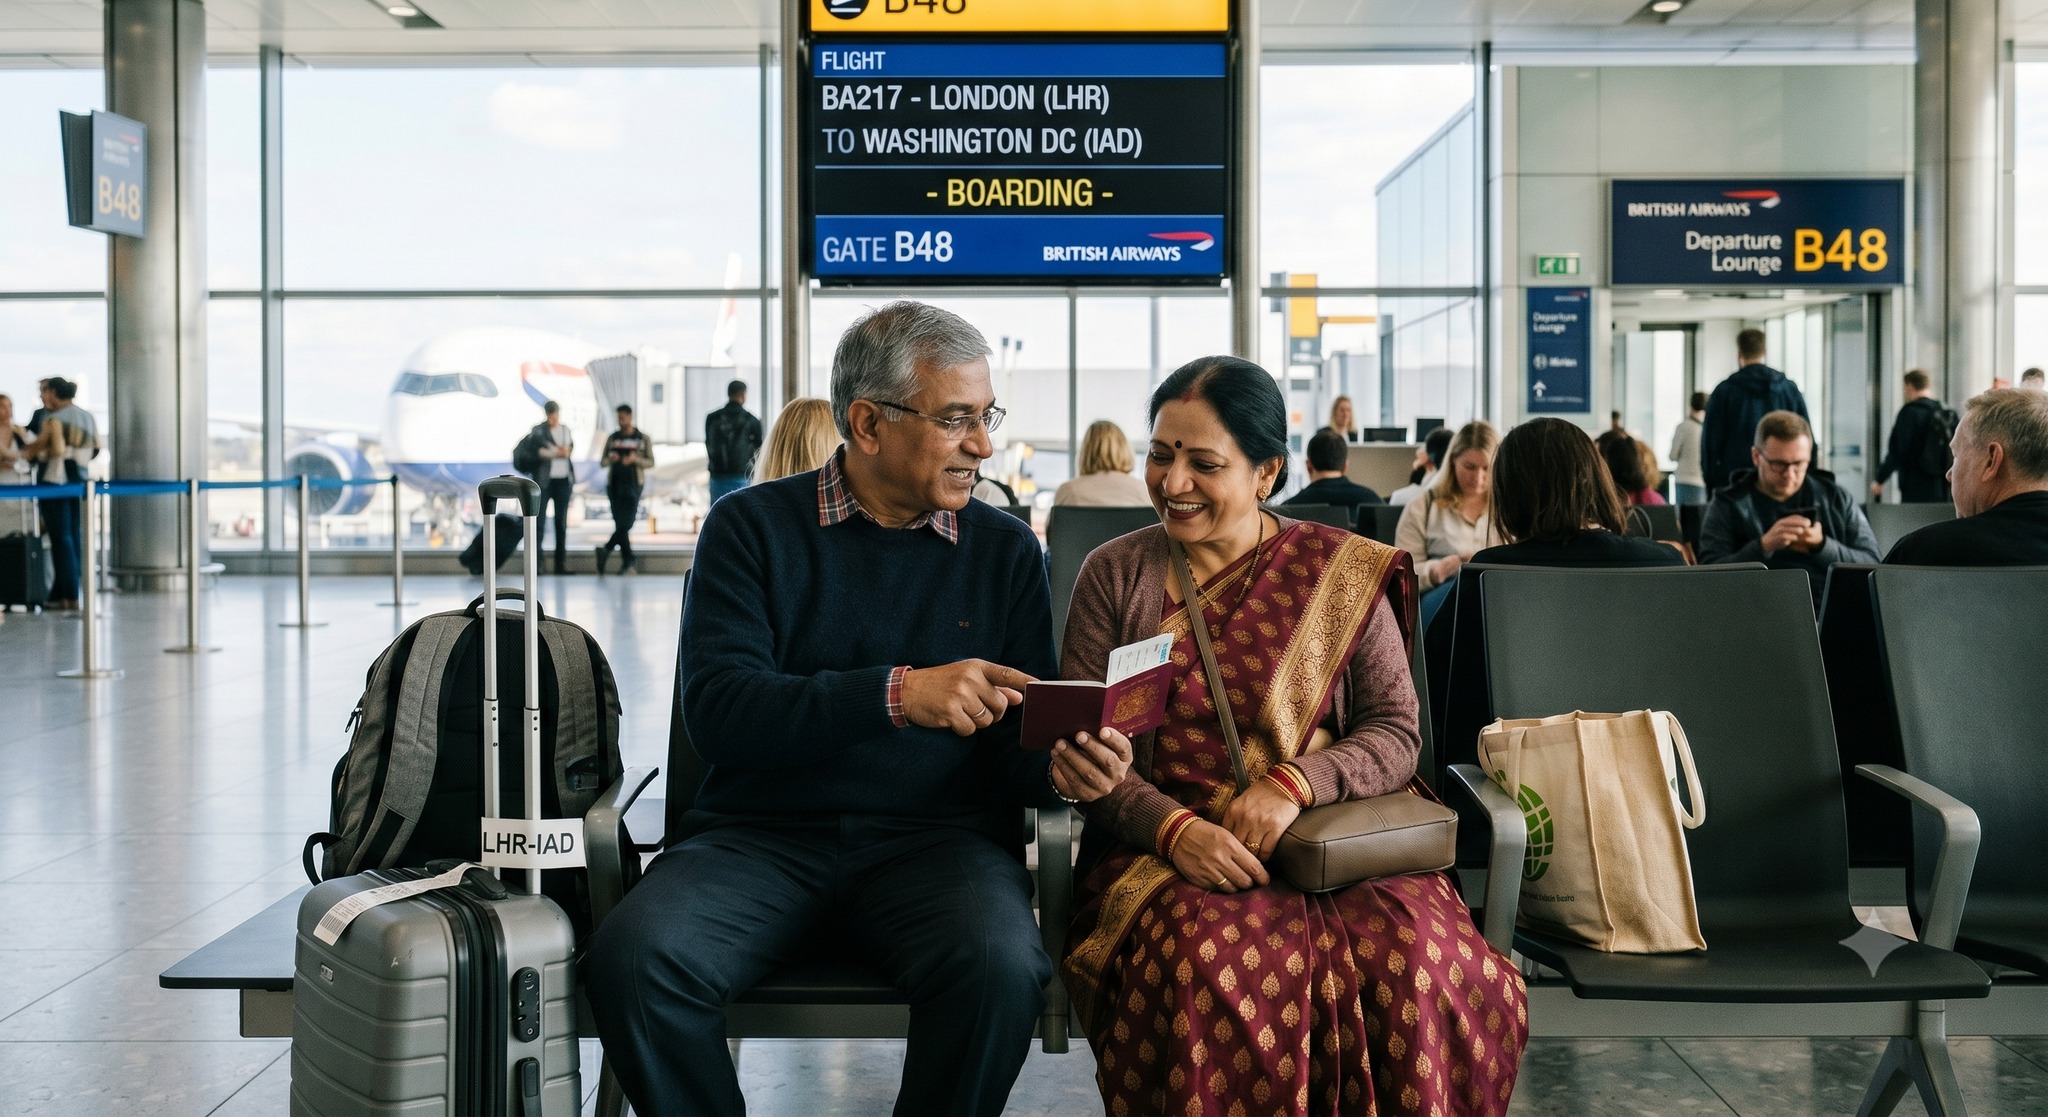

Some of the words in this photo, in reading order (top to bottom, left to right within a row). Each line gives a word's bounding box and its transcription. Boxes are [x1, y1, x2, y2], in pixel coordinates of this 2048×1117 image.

[821, 51, 886, 70] FLIGHT
[822, 85, 903, 110] BA217
[930, 85, 1035, 110] LONDON
[1043, 85, 1110, 115] (LHR)
[822, 128, 855, 154] TO
[862, 128, 1032, 154] WASHINGTON
[1041, 128, 1077, 154] DC
[1083, 128, 1143, 158] (IAD)
[98, 175, 141, 222] B48
[947, 178, 1093, 207] BOARDING
[1627, 202, 1686, 217] BRITISH
[1687, 202, 1751, 217] AIRWAYS
[822, 236, 887, 263] GATE
[895, 230, 954, 263] B48
[1043, 246, 1108, 261] BRITISH
[1110, 246, 1182, 261] AIRWAYS
[1686, 230, 1782, 255] Departure
[1794, 228, 1889, 272] B48
[1711, 254, 1782, 276] Lounge
[482, 831, 574, 855] LHR-IAD
